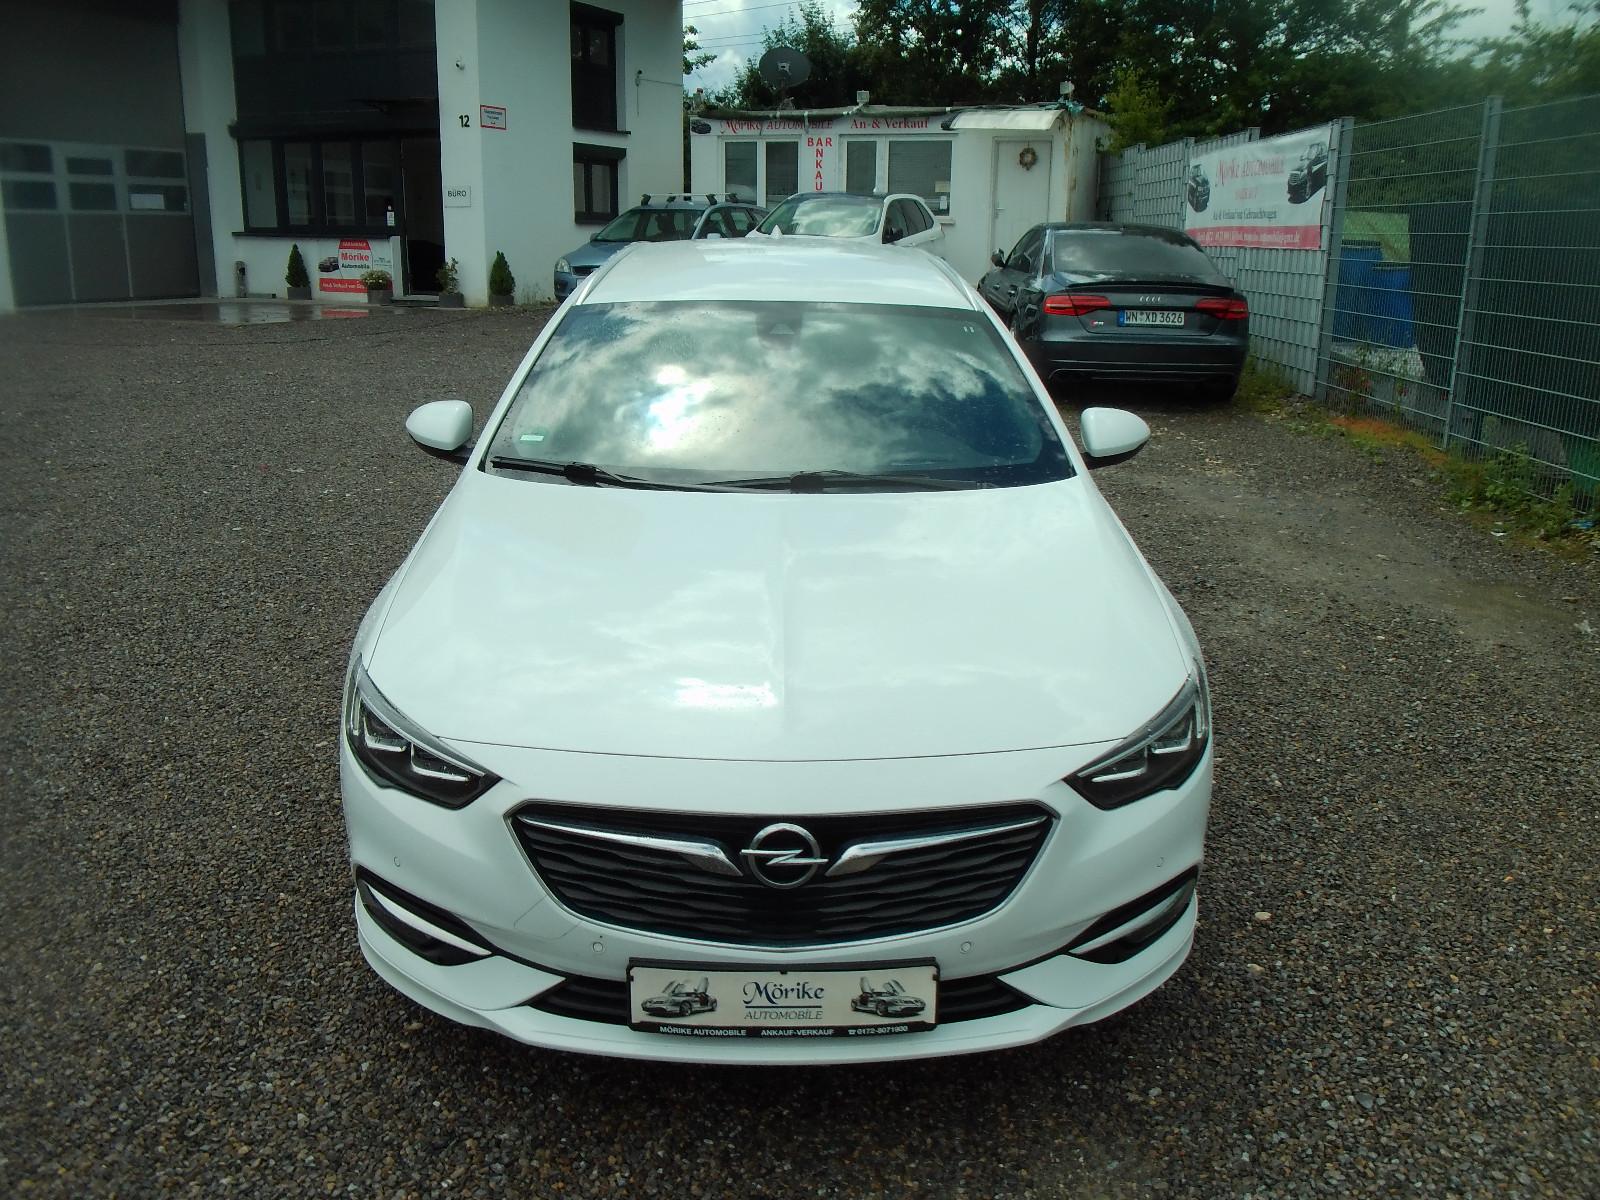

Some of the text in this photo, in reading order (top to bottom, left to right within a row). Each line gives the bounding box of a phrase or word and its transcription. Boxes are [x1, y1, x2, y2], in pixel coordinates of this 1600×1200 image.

[458, 114, 471, 128] 12
[850, 118, 929, 129] An & Verkauf
[807, 137, 833, 147] BAR
[447, 189, 467, 198] BÜRO
[1124, 311, 1184, 325] WN XD 3626
[742, 981, 825, 1005] Mörike
[659, 1025, 692, 1035] MÖRIKE
[693, 1027, 747, 1037] AUTOMOBILE
[761, 1028, 835, 1037] ANKAUF-VERKAUF
